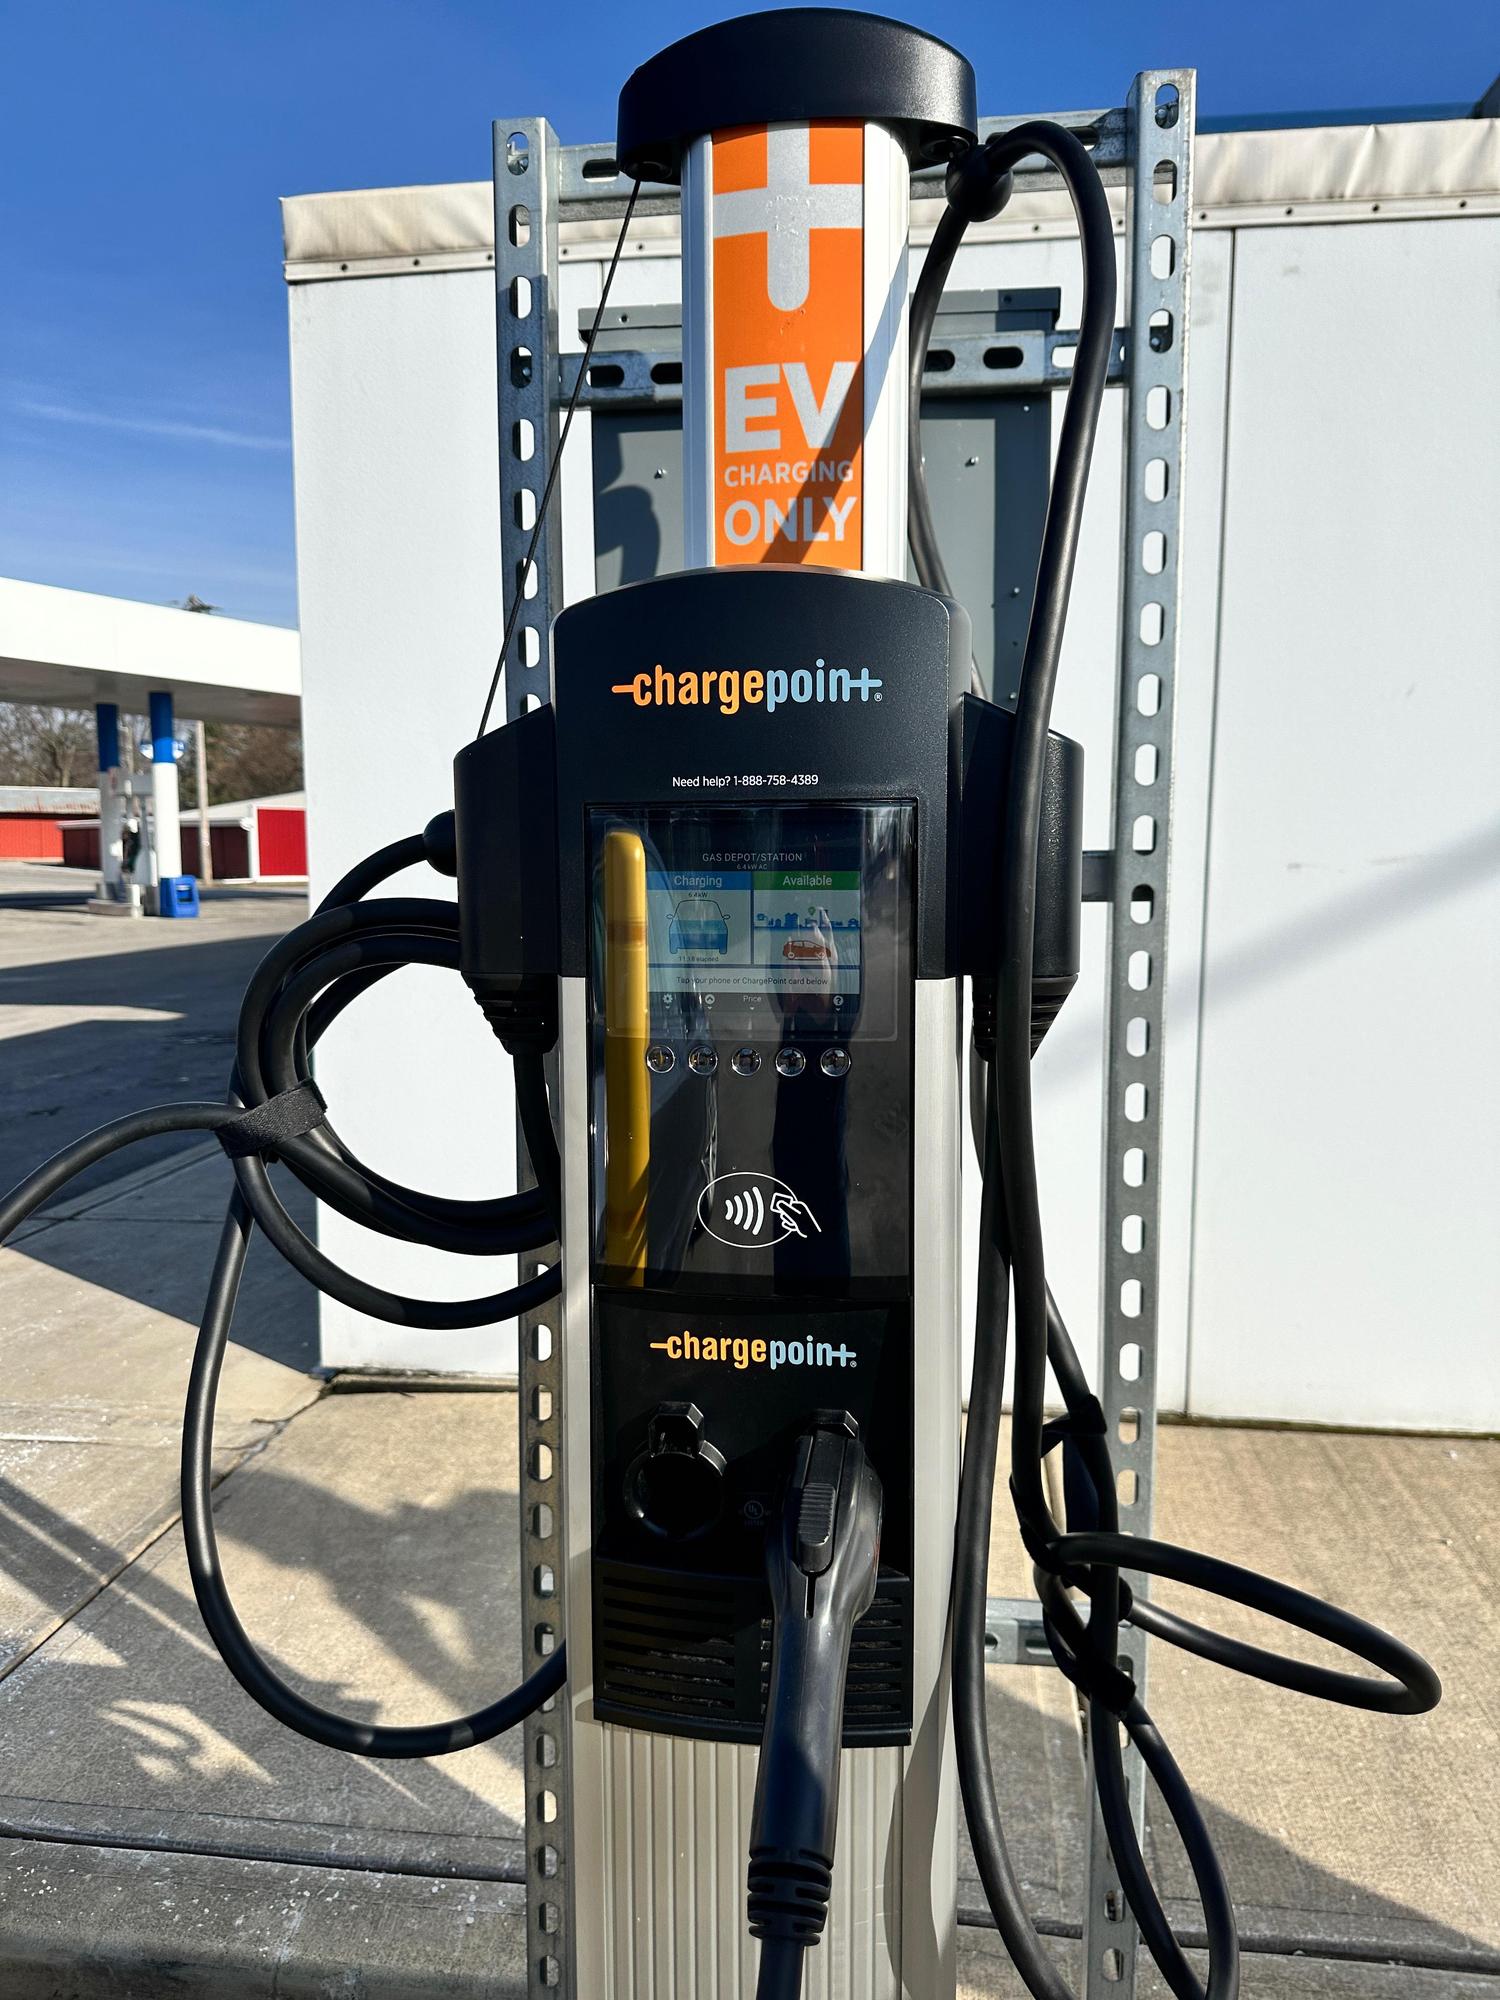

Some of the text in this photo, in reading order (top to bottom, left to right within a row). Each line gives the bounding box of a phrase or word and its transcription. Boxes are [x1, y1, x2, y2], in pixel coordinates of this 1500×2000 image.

[724, 361, 859, 454] EV
[723, 460, 854, 487] CHARGING
[723, 496, 858, 546] ONLY
[672, 774, 819, 788] Need help? 1-888-758-4389
[702, 853, 802, 862] GAS DEPOT/STATION
[674, 875, 722, 888] Charging
[783, 875, 833, 886] Available
[676, 976, 690, 986] Tap
[709, 976, 731, 986] phone
[742, 976, 787, 986] ChargePoint
[788, 976, 805, 985] card
[806, 976, 828, 985] below
